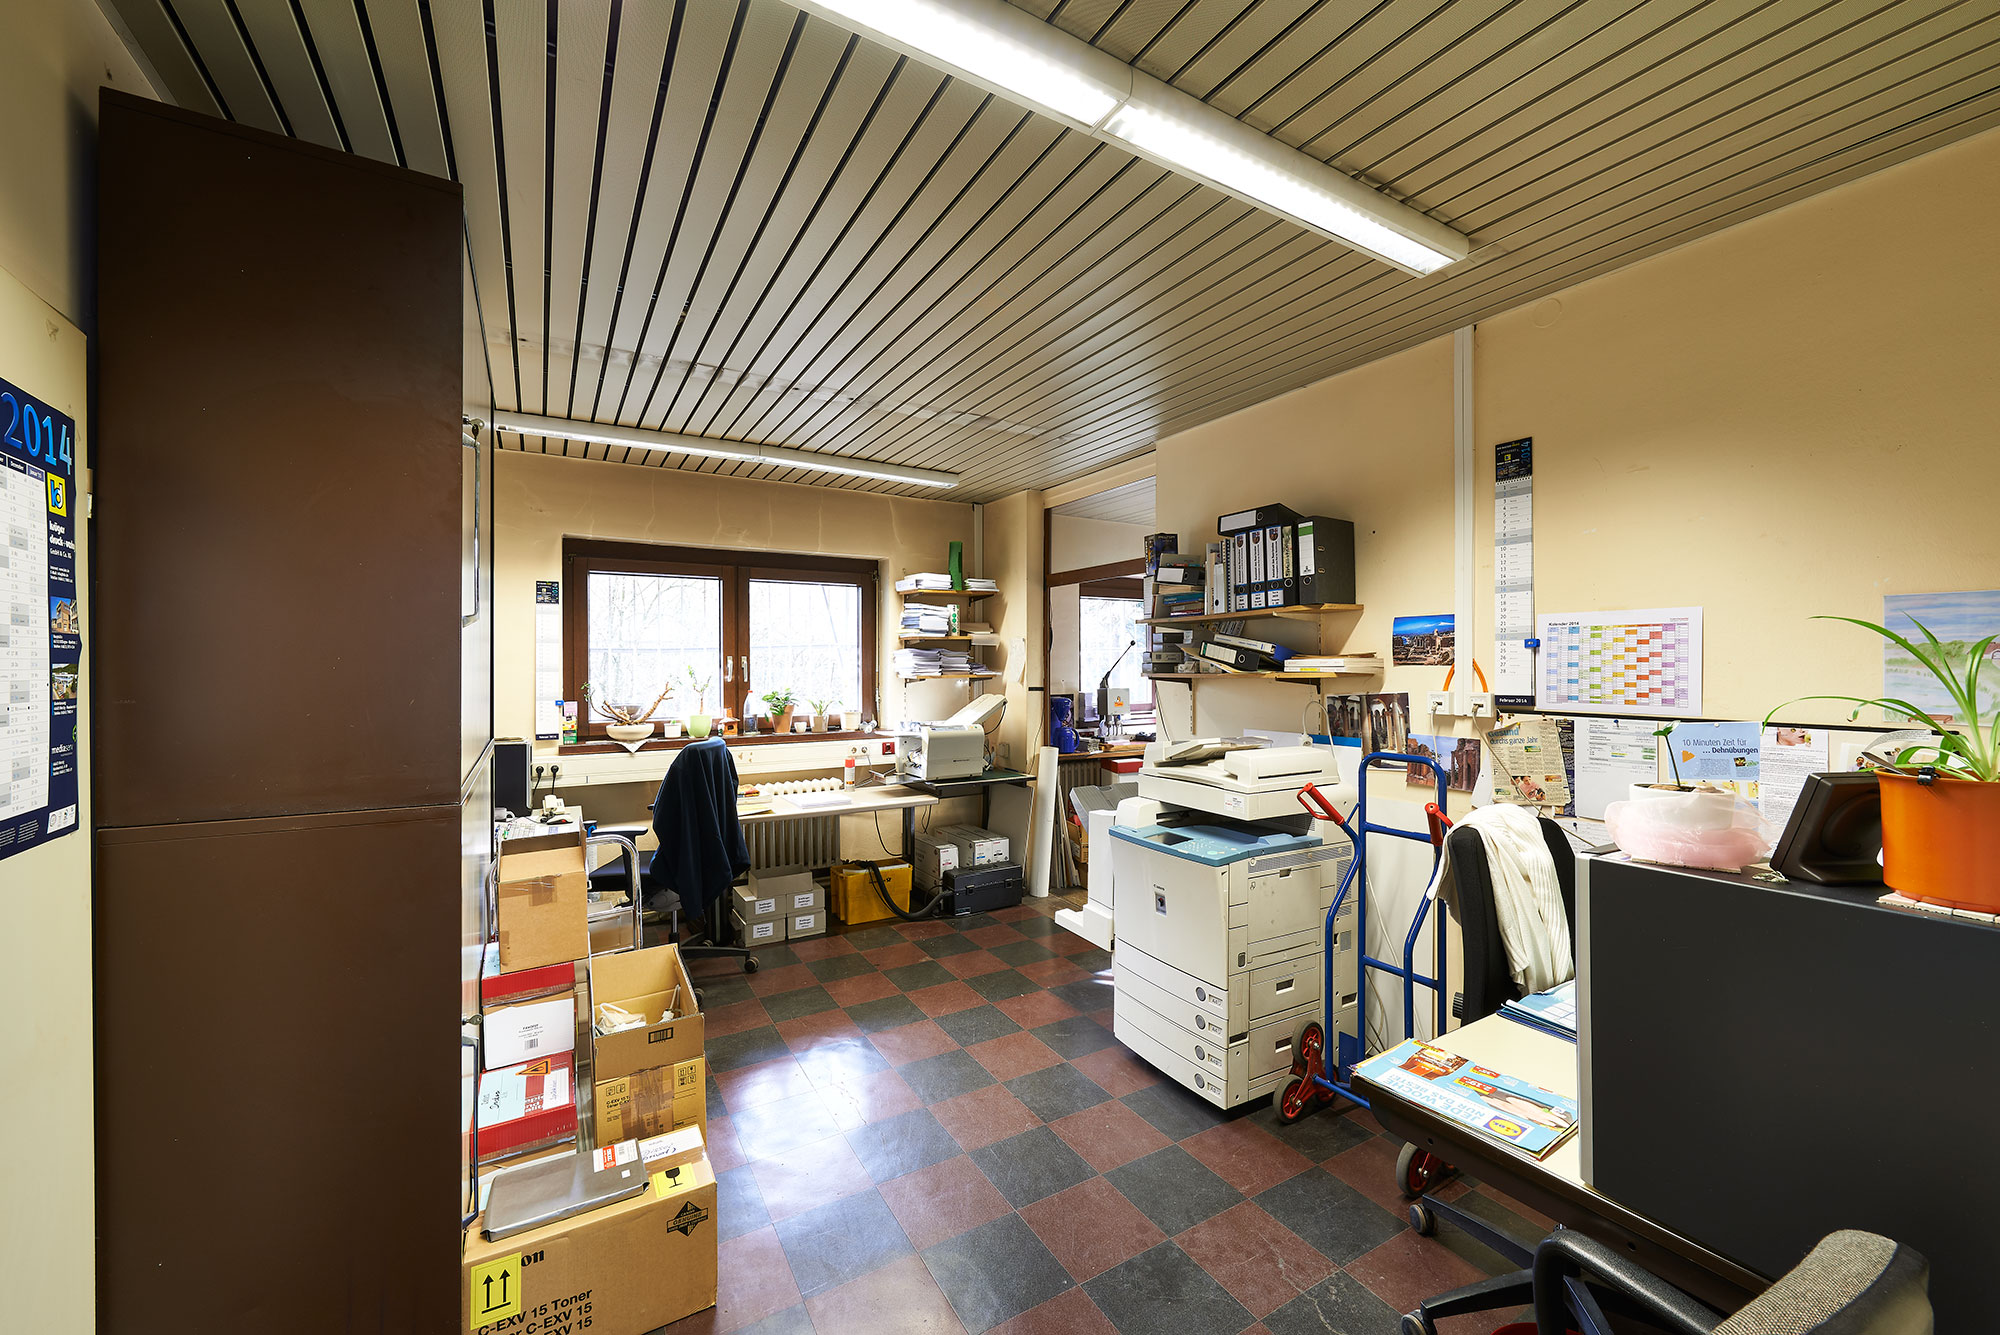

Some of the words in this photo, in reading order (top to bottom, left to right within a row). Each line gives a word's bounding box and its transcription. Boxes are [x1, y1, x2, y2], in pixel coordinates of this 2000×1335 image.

[1, 391, 72, 475] 2014
[1487, 727, 1519, 738] Gesund
[1490, 737, 1508, 745] durchs
[1526, 736, 1538, 744] Jahr
[1692, 738, 1721, 746] Minuten
[1722, 738, 1736, 746] Zeit
[1737, 738, 1747, 746] für
[1711, 746, 1759, 755] Dehnübungen
[1383, 1078, 1437, 1104] WOCHE
[1431, 1091, 1455, 1104] DAS
[1440, 1102, 1481, 1121] JEDE
[1458, 1103, 1485, 1117] NUR
[478, 1310, 527, 1335] C-EXV
[531, 1304, 547, 1318] 15
[551, 1289, 593, 1311] Toner
[526, 1308, 573, 1334] C-EXV
[576, 1302, 592, 1316] 15
[576, 1316, 592, 1330] 15
